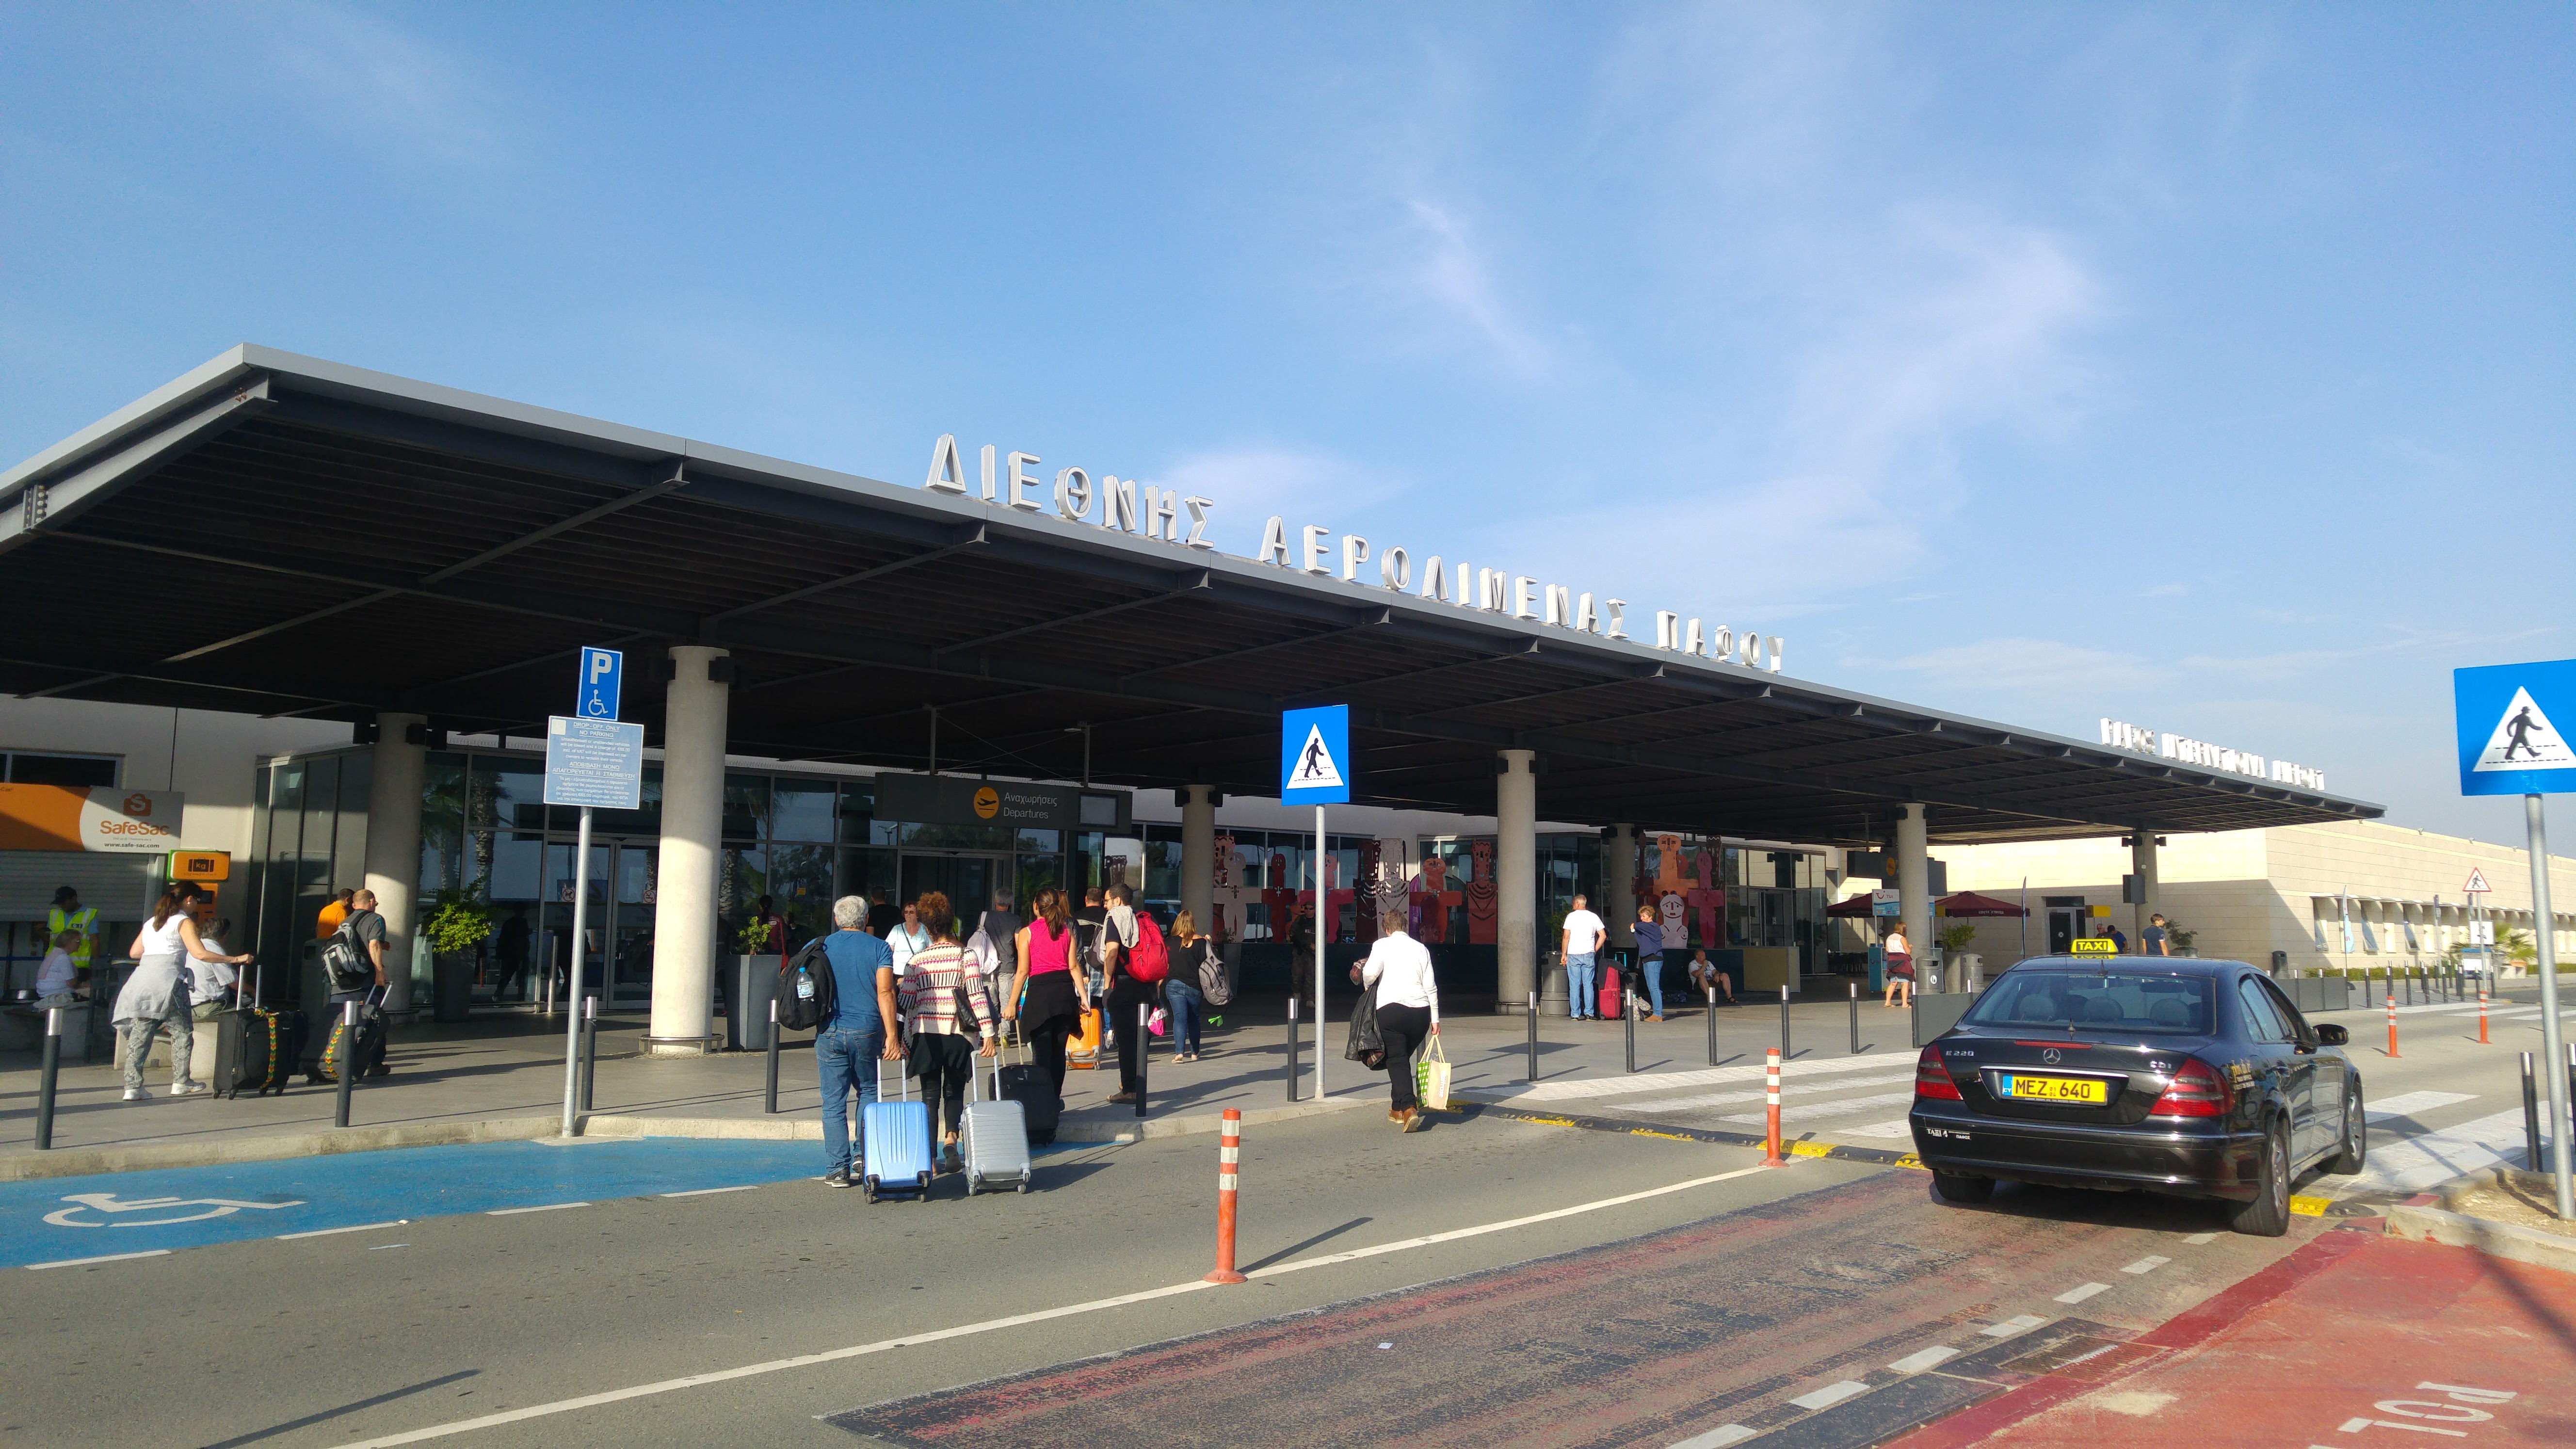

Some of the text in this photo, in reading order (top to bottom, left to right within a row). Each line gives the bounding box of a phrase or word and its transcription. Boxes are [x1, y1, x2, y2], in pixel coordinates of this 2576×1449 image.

[926, 433, 1784, 672] ΔΙΕΘΝΗΣ ΑΕΡΟΛΙΜΕΝΑΣ ΠΑΦΟΥ
[590, 652, 612, 684] P
[1004, 792, 1058, 807] Αναχωρήσεις
[1003, 807, 1048, 819] Departures
[99, 821, 170, 836] SafeSac
[2078, 942, 2107, 950] TAXI
[2015, 1079, 2090, 1098] MEZ 640
